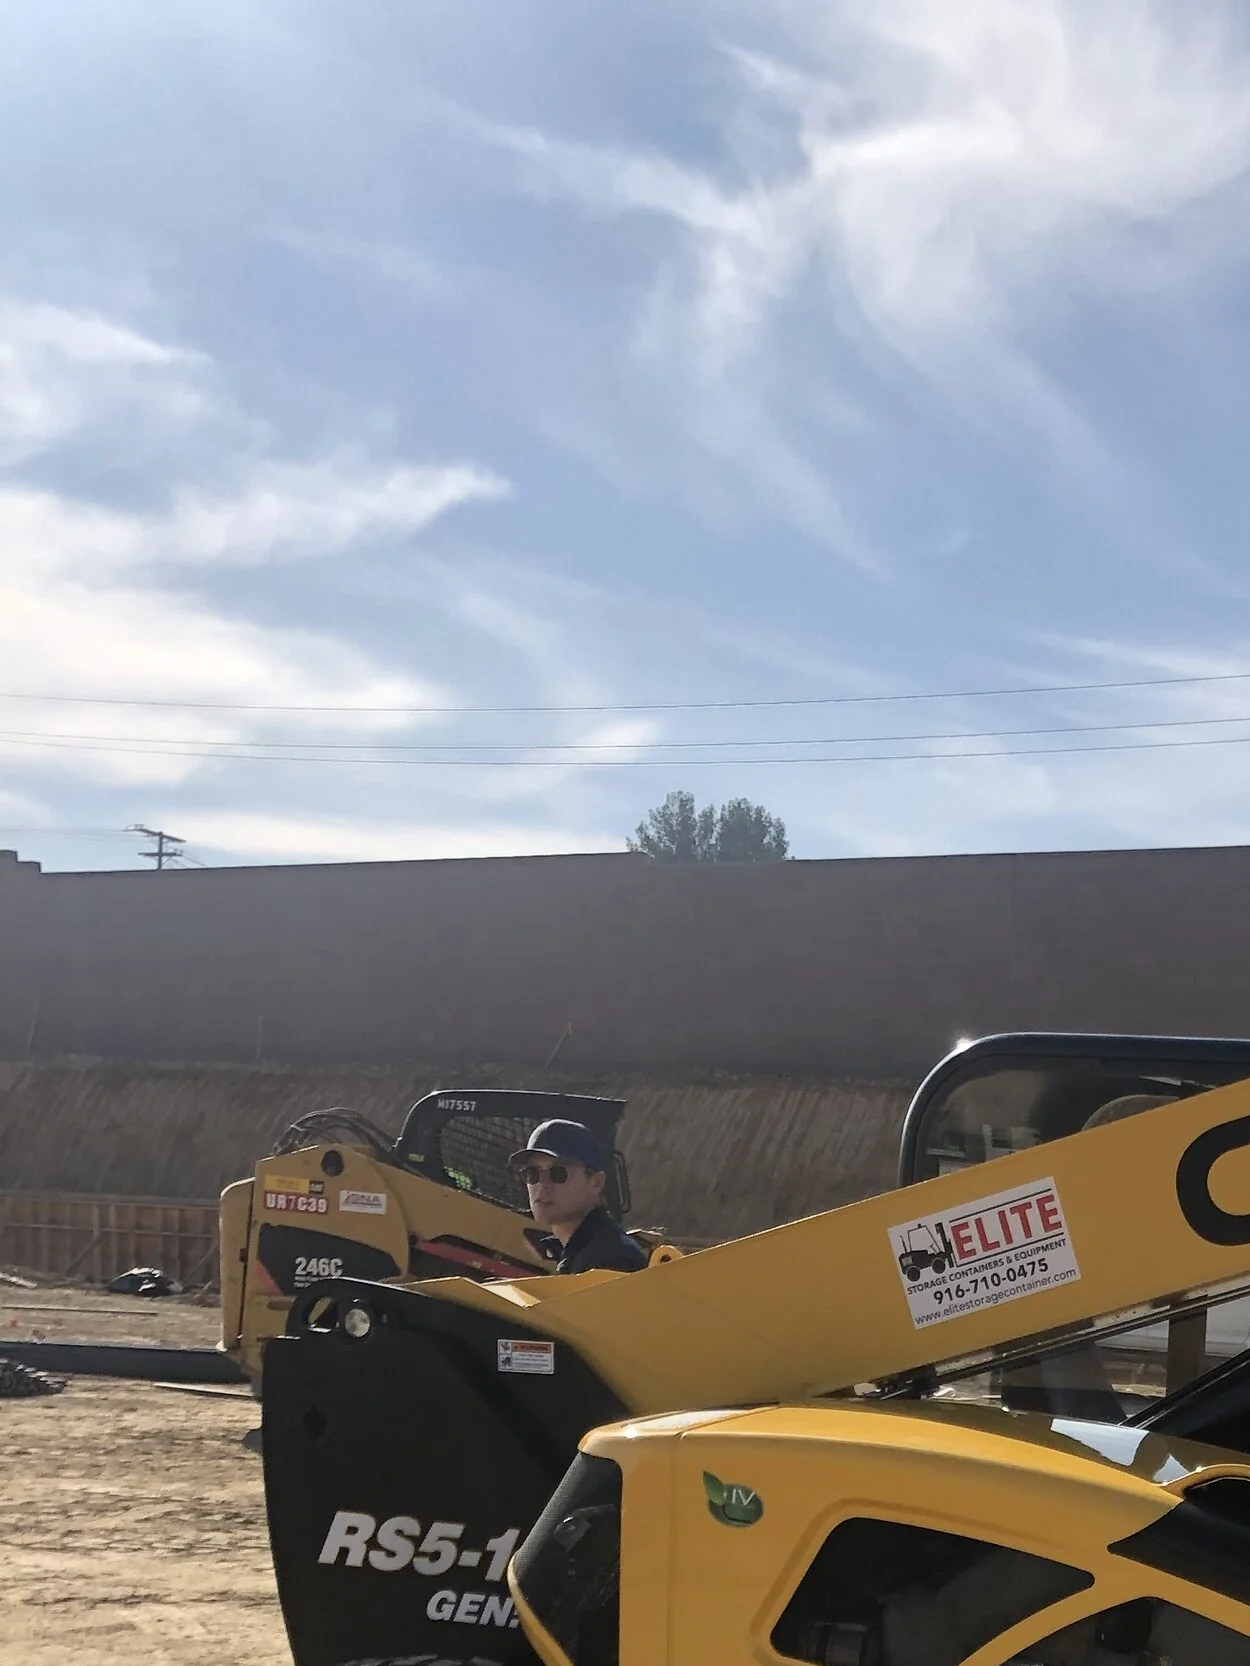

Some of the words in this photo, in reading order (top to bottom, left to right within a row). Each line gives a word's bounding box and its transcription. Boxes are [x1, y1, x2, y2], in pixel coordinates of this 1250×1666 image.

[951, 1193, 1063, 1260] ELITE
[294, 1257, 343, 1277] 246C
[907, 1276, 948, 1295] STORAGE
[949, 1258, 1004, 1282] CONTAINERS
[1014, 1238, 1067, 1262] EQUIPMENT
[933, 1258, 1050, 1304] 916-710-0475
[915, 1267, 1077, 1325] www.elitestoragecontainer.com
